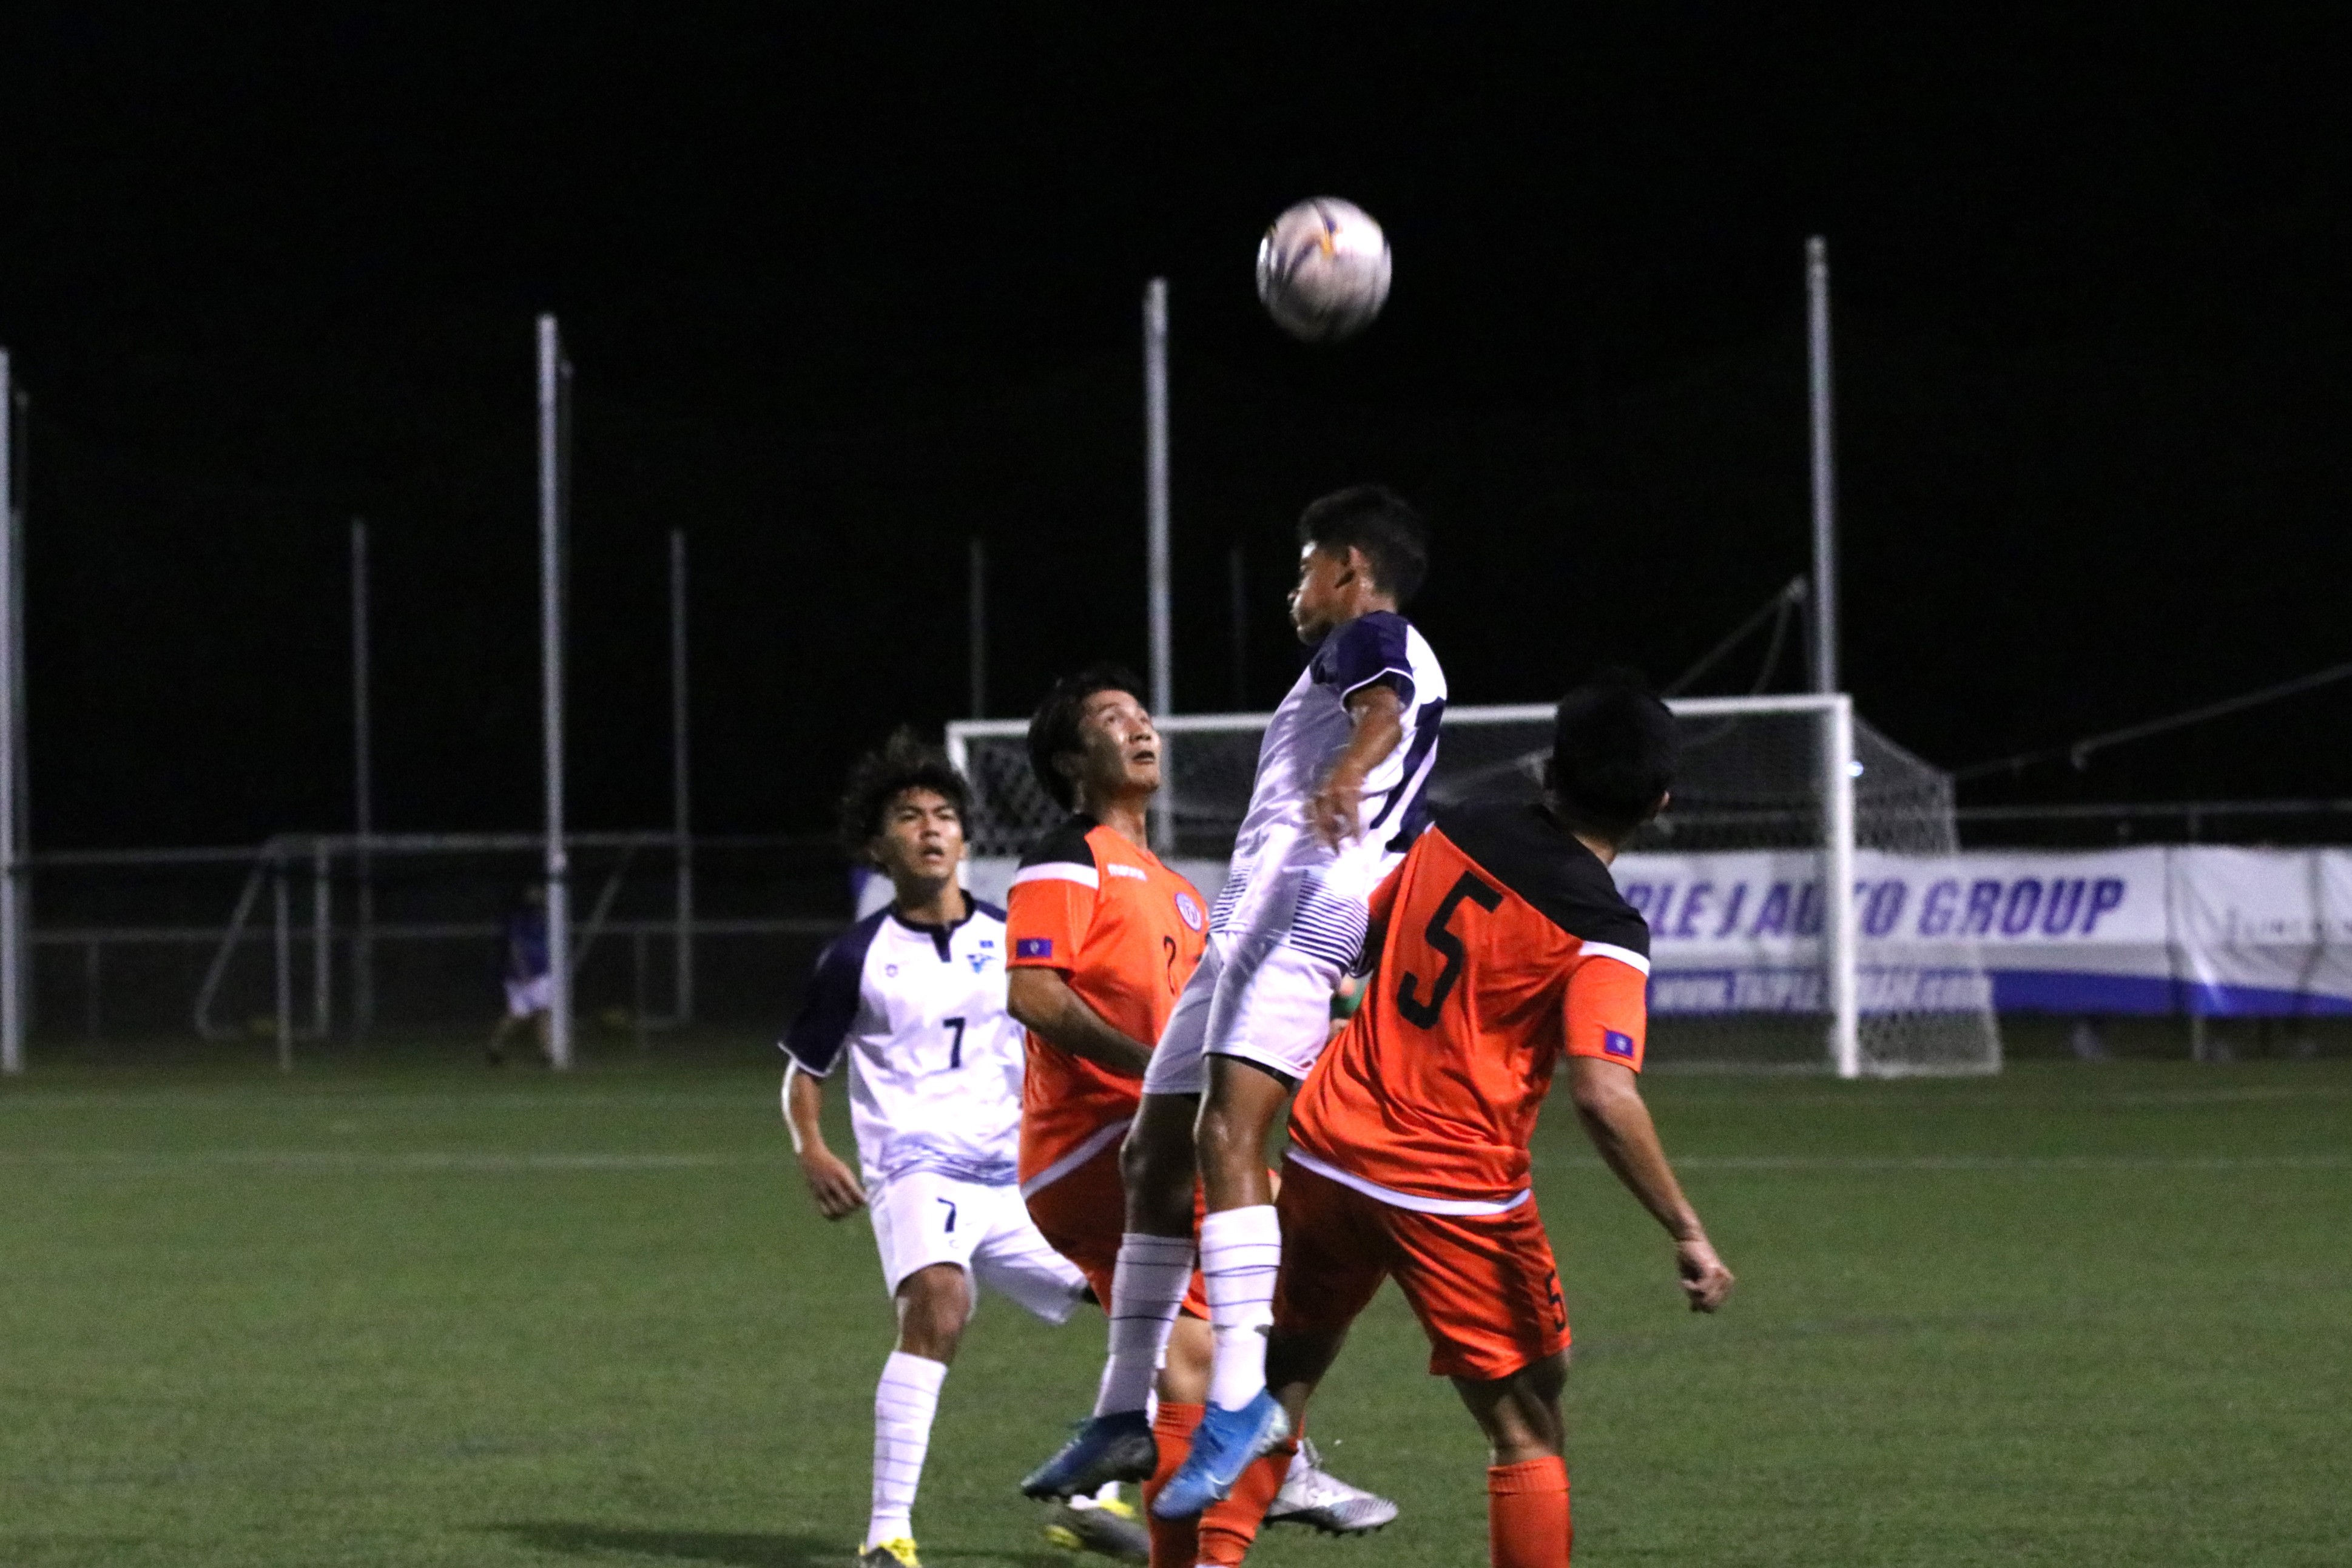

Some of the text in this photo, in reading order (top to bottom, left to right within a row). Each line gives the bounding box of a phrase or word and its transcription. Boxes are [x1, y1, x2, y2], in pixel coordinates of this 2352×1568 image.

[1619, 877, 2125, 939] PLE J AUO GROUP
[1397, 870, 1503, 1029] 5
[943, 1017, 966, 1068] 7
[937, 1197, 957, 1233] 7
[1545, 1269, 1566, 1333] 5
